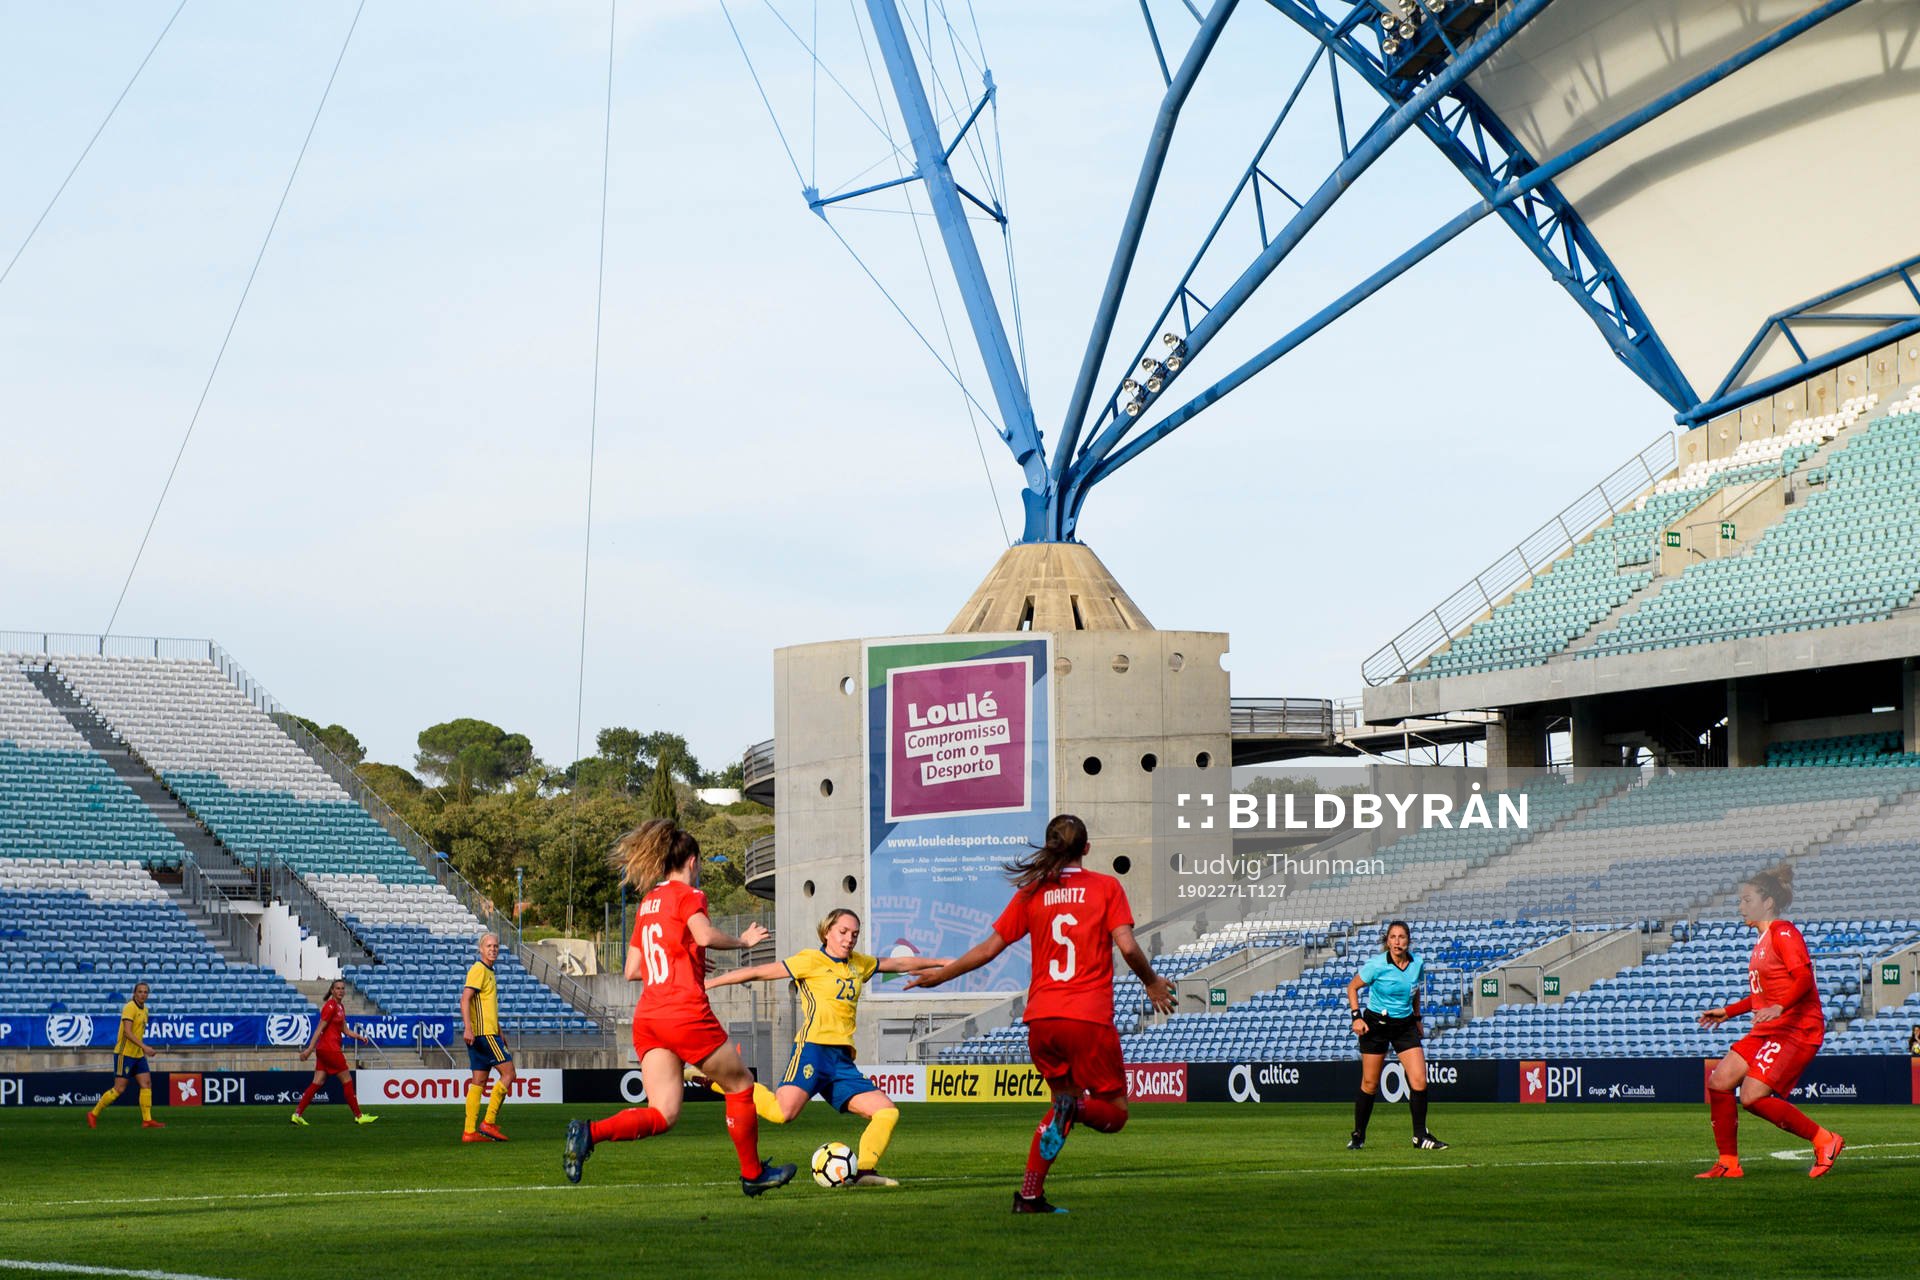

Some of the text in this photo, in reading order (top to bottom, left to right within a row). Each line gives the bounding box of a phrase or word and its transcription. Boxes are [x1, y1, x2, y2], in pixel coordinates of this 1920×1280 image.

[908, 691, 998, 728] Loulé
[908, 724, 1006, 749] Compromisso
[936, 745, 979, 761] com o
[927, 759, 994, 780] Desporto
[888, 834, 1028, 848] www.louledesporto.com
[1044, 887, 1086, 906] MARITZ
[642, 923, 669, 986] 16
[1049, 913, 1078, 982] 5
[1883, 968, 1899, 980] S07
[836, 978, 856, 1000] 23
[1544, 980, 1558, 991] S07
[200, 1022, 234, 1038] CUP
[412, 1024, 445, 1039] CUP
[1756, 1040, 1781, 1064] 22
[930, 1069, 979, 1096] Hertz
[993, 1069, 1044, 1096] Hertz
[1136, 1069, 1184, 1097] SAGRES
[1259, 1065, 1300, 1085] altice
[1425, 1063, 1458, 1084] ltice
[1547, 1067, 1656, 1097] BPI Grupo CaixaBank
[34, 1094, 56, 1103] Grupo
[204, 1077, 329, 1103] BPI Grupo CaBank
[383, 1078, 541, 1099] CONTIETE
[1819, 1084, 1857, 1095] CaixaBank
